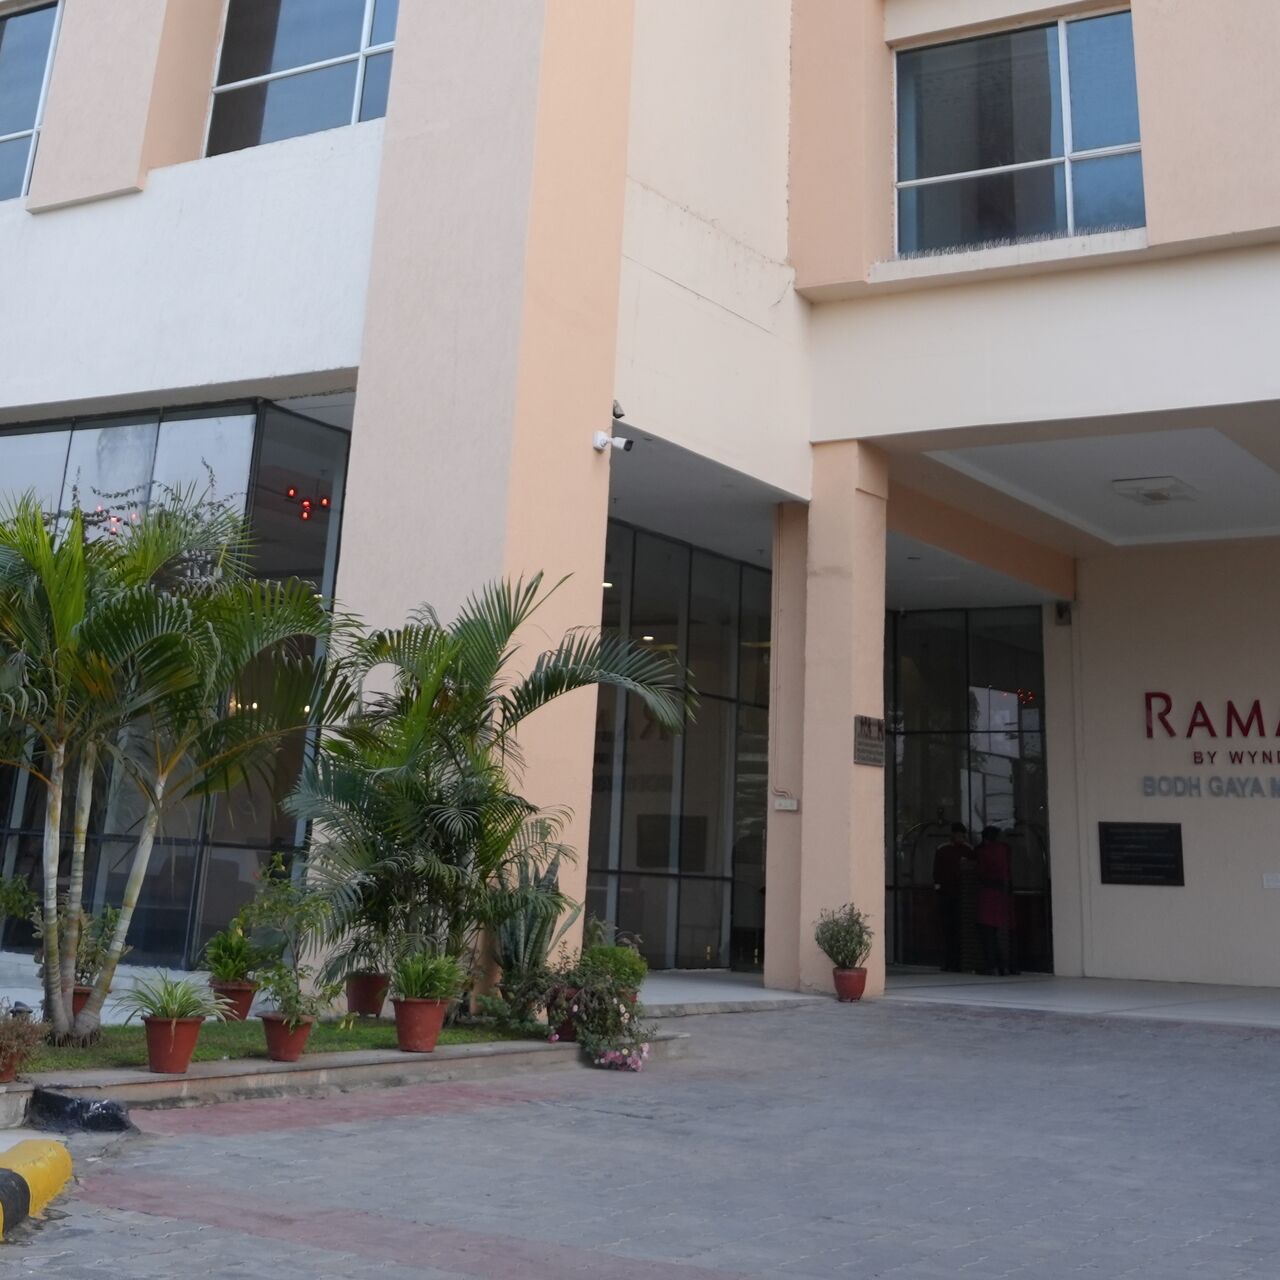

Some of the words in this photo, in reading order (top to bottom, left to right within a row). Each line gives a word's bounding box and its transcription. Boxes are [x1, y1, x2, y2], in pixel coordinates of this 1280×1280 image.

[1192, 750, 1218, 765] BY
[1142, 775, 1202, 799] BODH
[1208, 776, 1267, 799] GAYA
